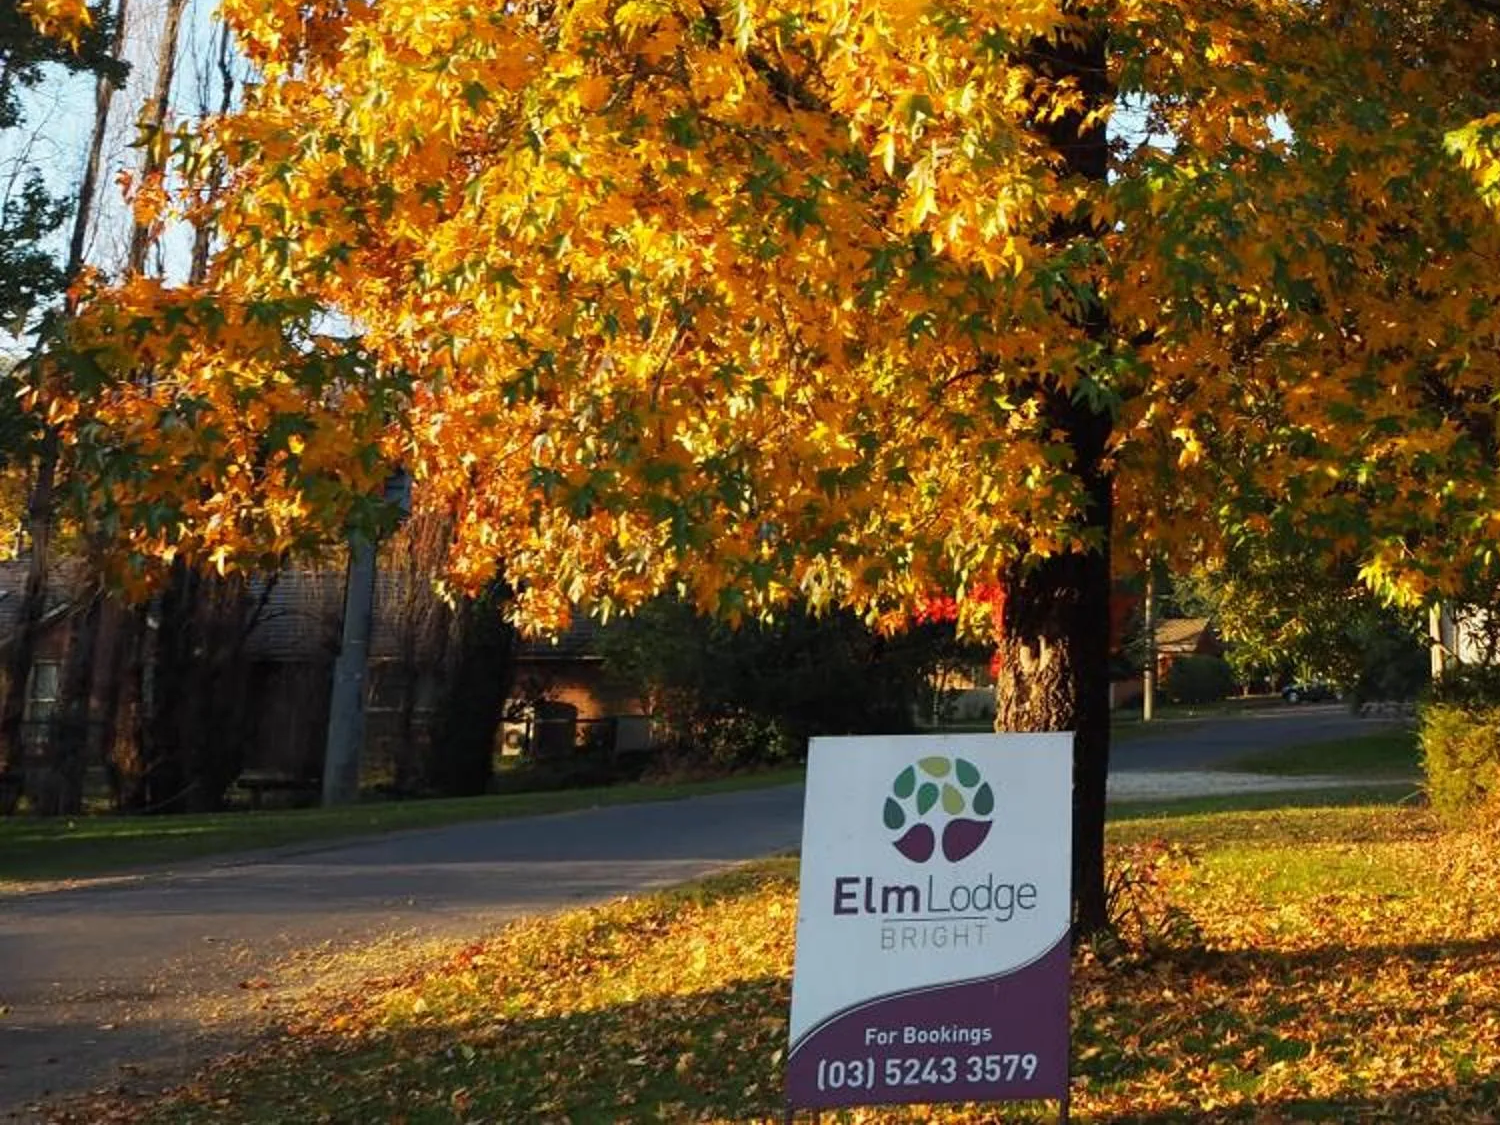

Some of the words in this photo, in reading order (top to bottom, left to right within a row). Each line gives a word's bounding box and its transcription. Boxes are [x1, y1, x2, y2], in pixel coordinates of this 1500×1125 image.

[880, 924, 989, 950] BRIGHT
[865, 1028, 898, 1046] For
[903, 1025, 993, 1045] Bookings
[816, 1058, 876, 1091] (03)
[884, 1058, 957, 1085] 5243
[966, 1054, 1038, 1081] 3579
